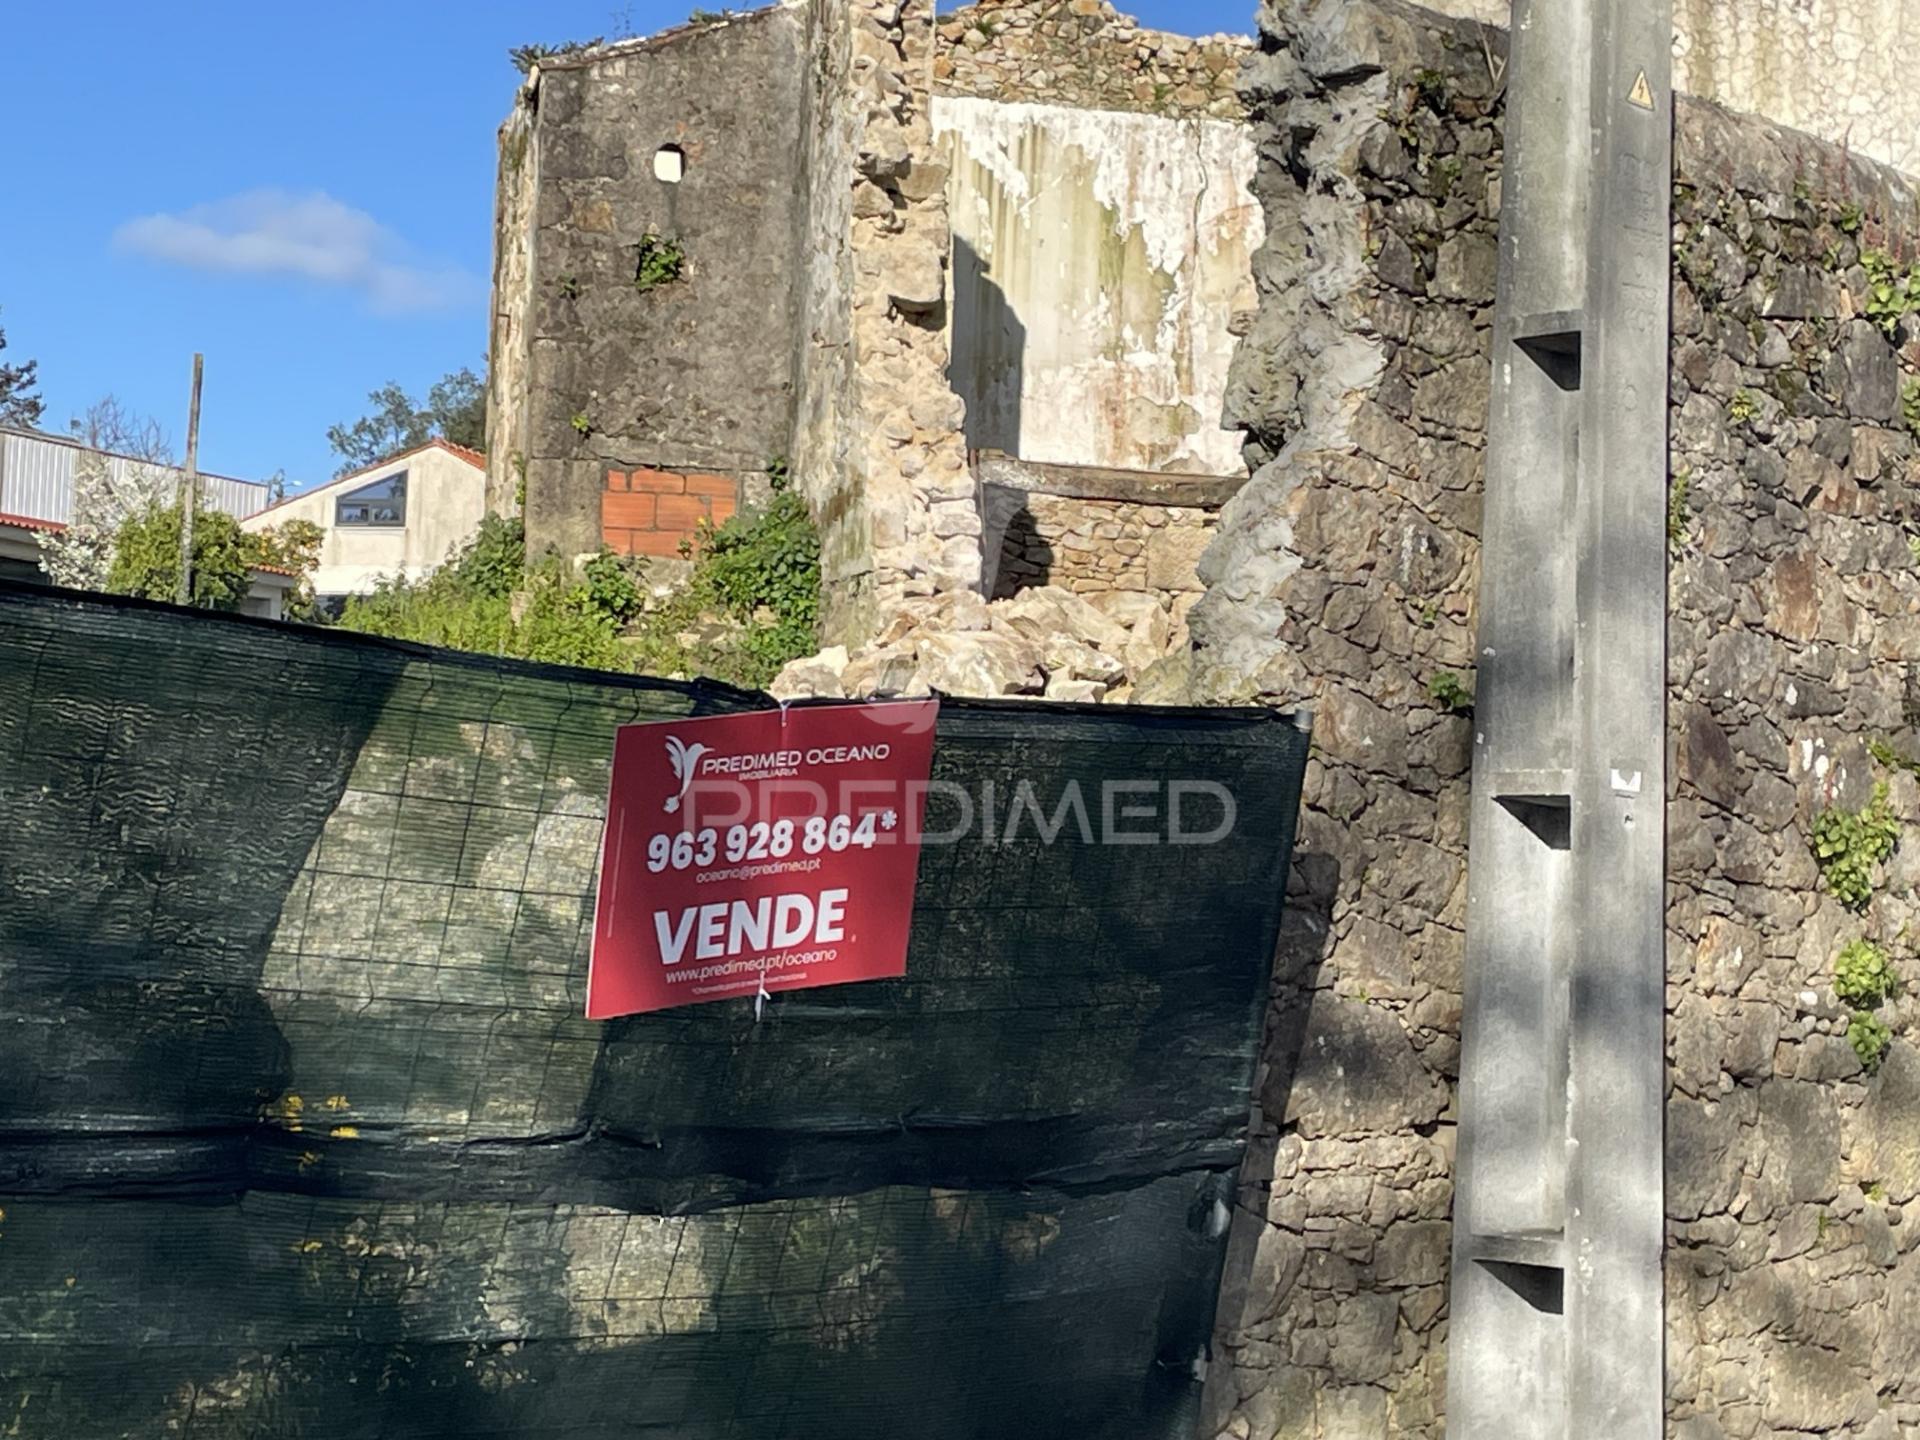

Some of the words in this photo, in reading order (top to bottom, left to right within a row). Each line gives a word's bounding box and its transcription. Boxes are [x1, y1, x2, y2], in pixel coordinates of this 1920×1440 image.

[702, 750, 802, 775] PREDIMED
[806, 744, 891, 766] OCEANO
[647, 829, 718, 873] 963
[725, 819, 795, 863] 928
[695, 857, 822, 884] oceano@predimed.pt
[653, 888, 849, 966] VENDE
[665, 948, 838, 984] www.predimed.pt/oceano
